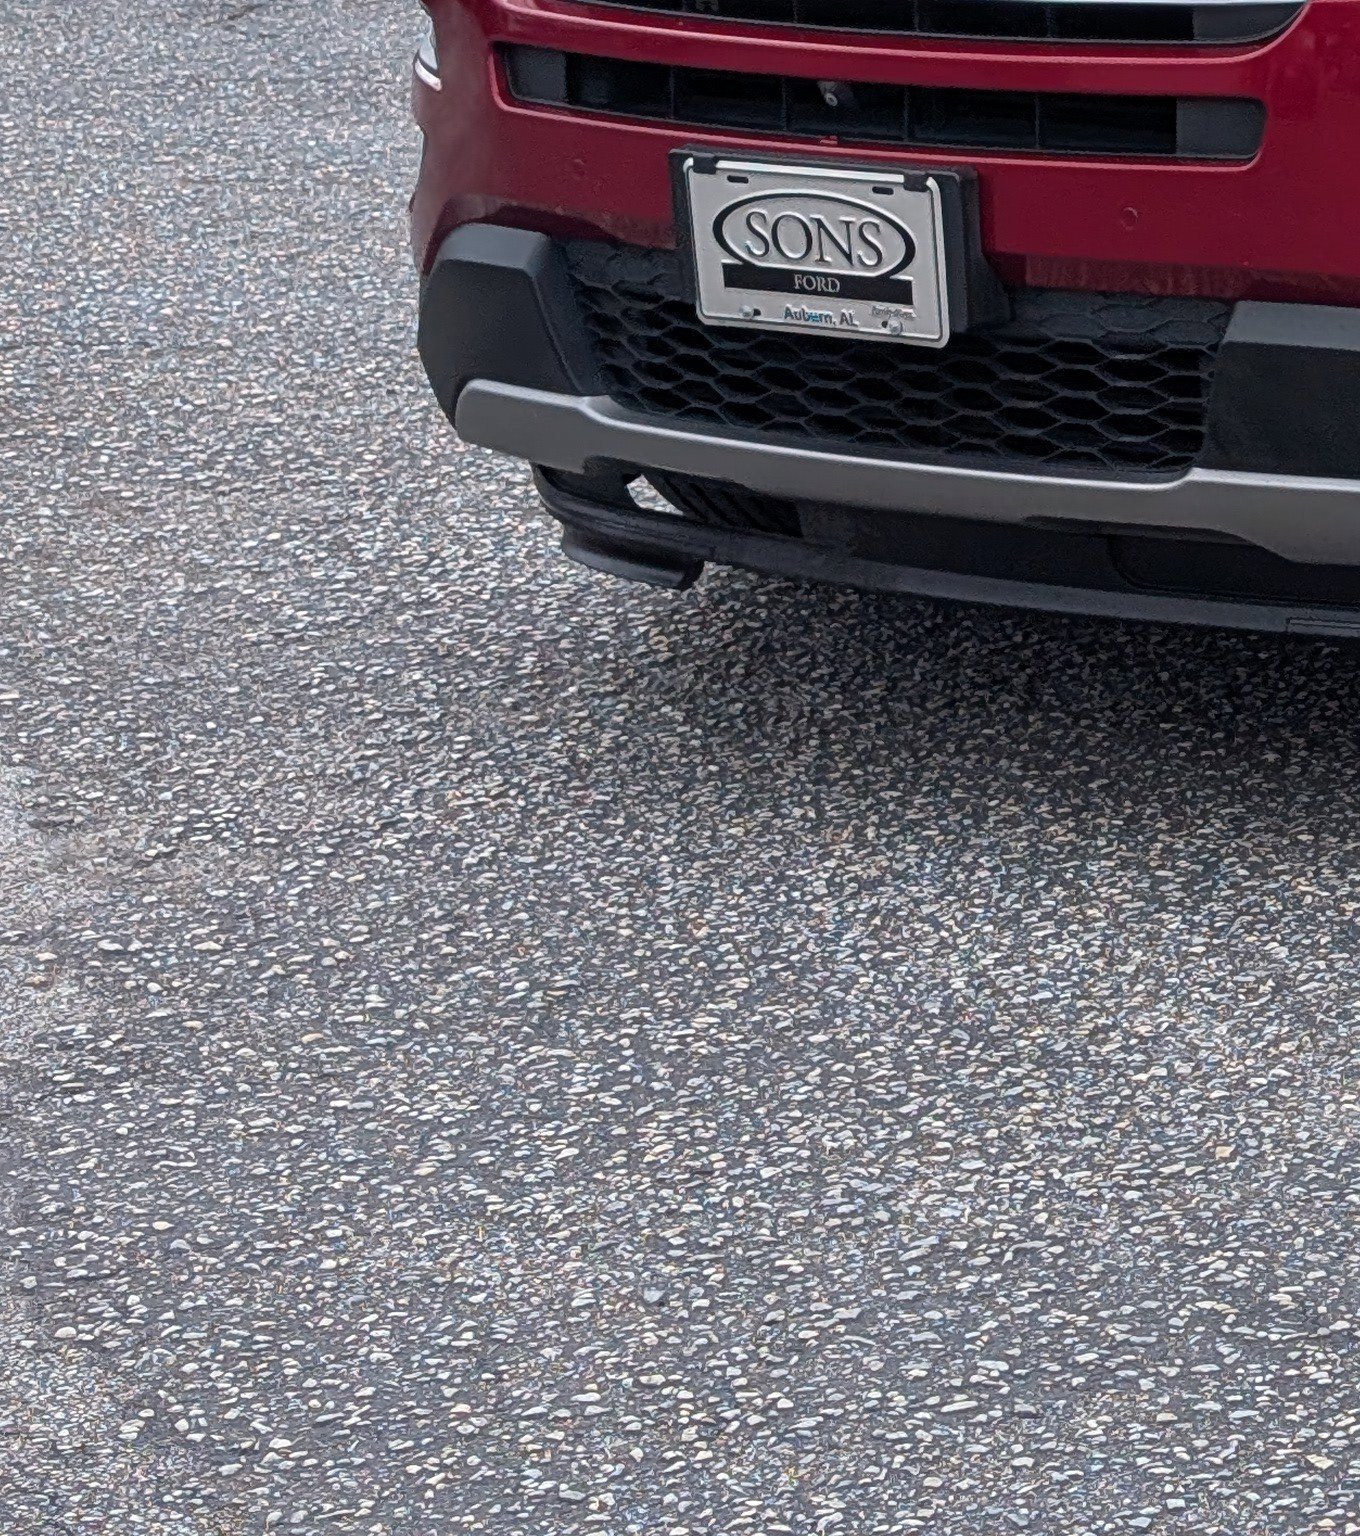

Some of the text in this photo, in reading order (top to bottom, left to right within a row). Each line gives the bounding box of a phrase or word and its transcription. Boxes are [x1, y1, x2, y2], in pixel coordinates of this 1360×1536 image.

[745, 209, 884, 267] SONS
[794, 273, 841, 293] FORD
[784, 304, 837, 327] Auburn,
[839, 308, 860, 328] AL
